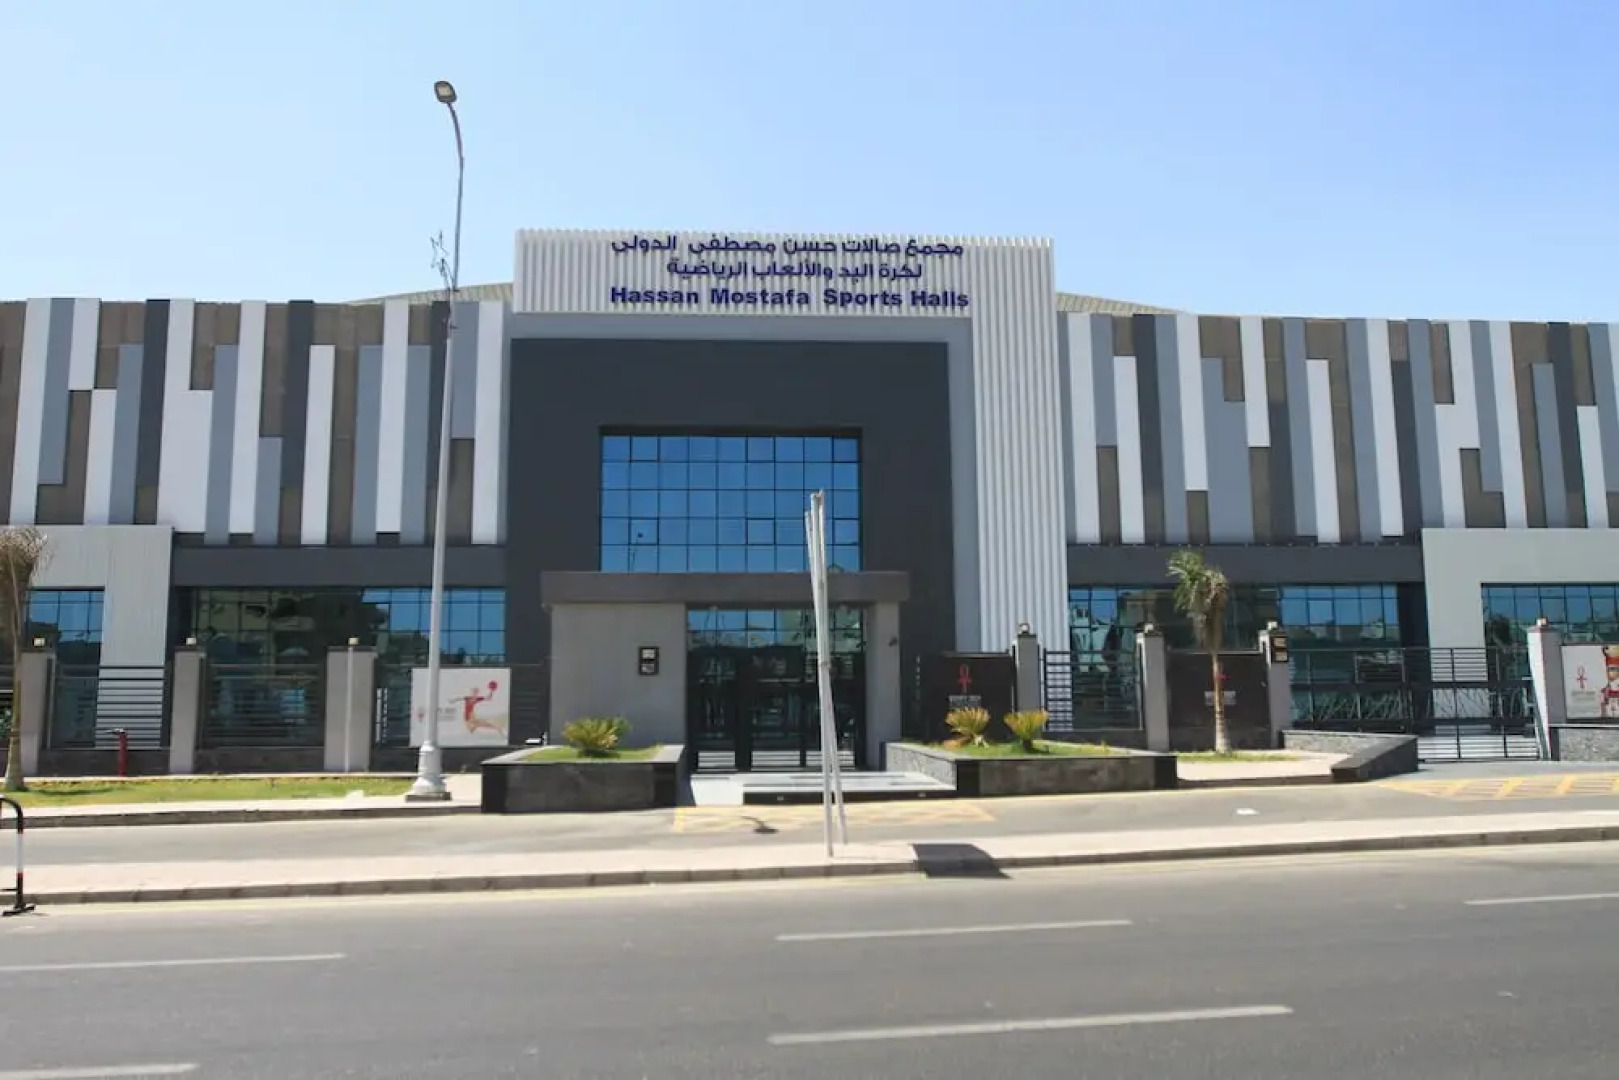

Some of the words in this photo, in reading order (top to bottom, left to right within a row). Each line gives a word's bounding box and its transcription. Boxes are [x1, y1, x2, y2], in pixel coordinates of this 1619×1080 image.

[688, 233, 776, 254] مصطفى
[783, 238, 837, 255] حسن
[841, 238, 901, 254] صالات
[905, 239, 964, 259] مجمع
[666, 257, 747, 279] الرياضية
[752, 259, 834, 281] والألعاب
[878, 263, 922, 280] لكرة
[611, 286, 699, 304] Hassan
[711, 287, 809, 305] Mostafa
[823, 289, 903, 307] Sports
[910, 290, 970, 307] Halls
